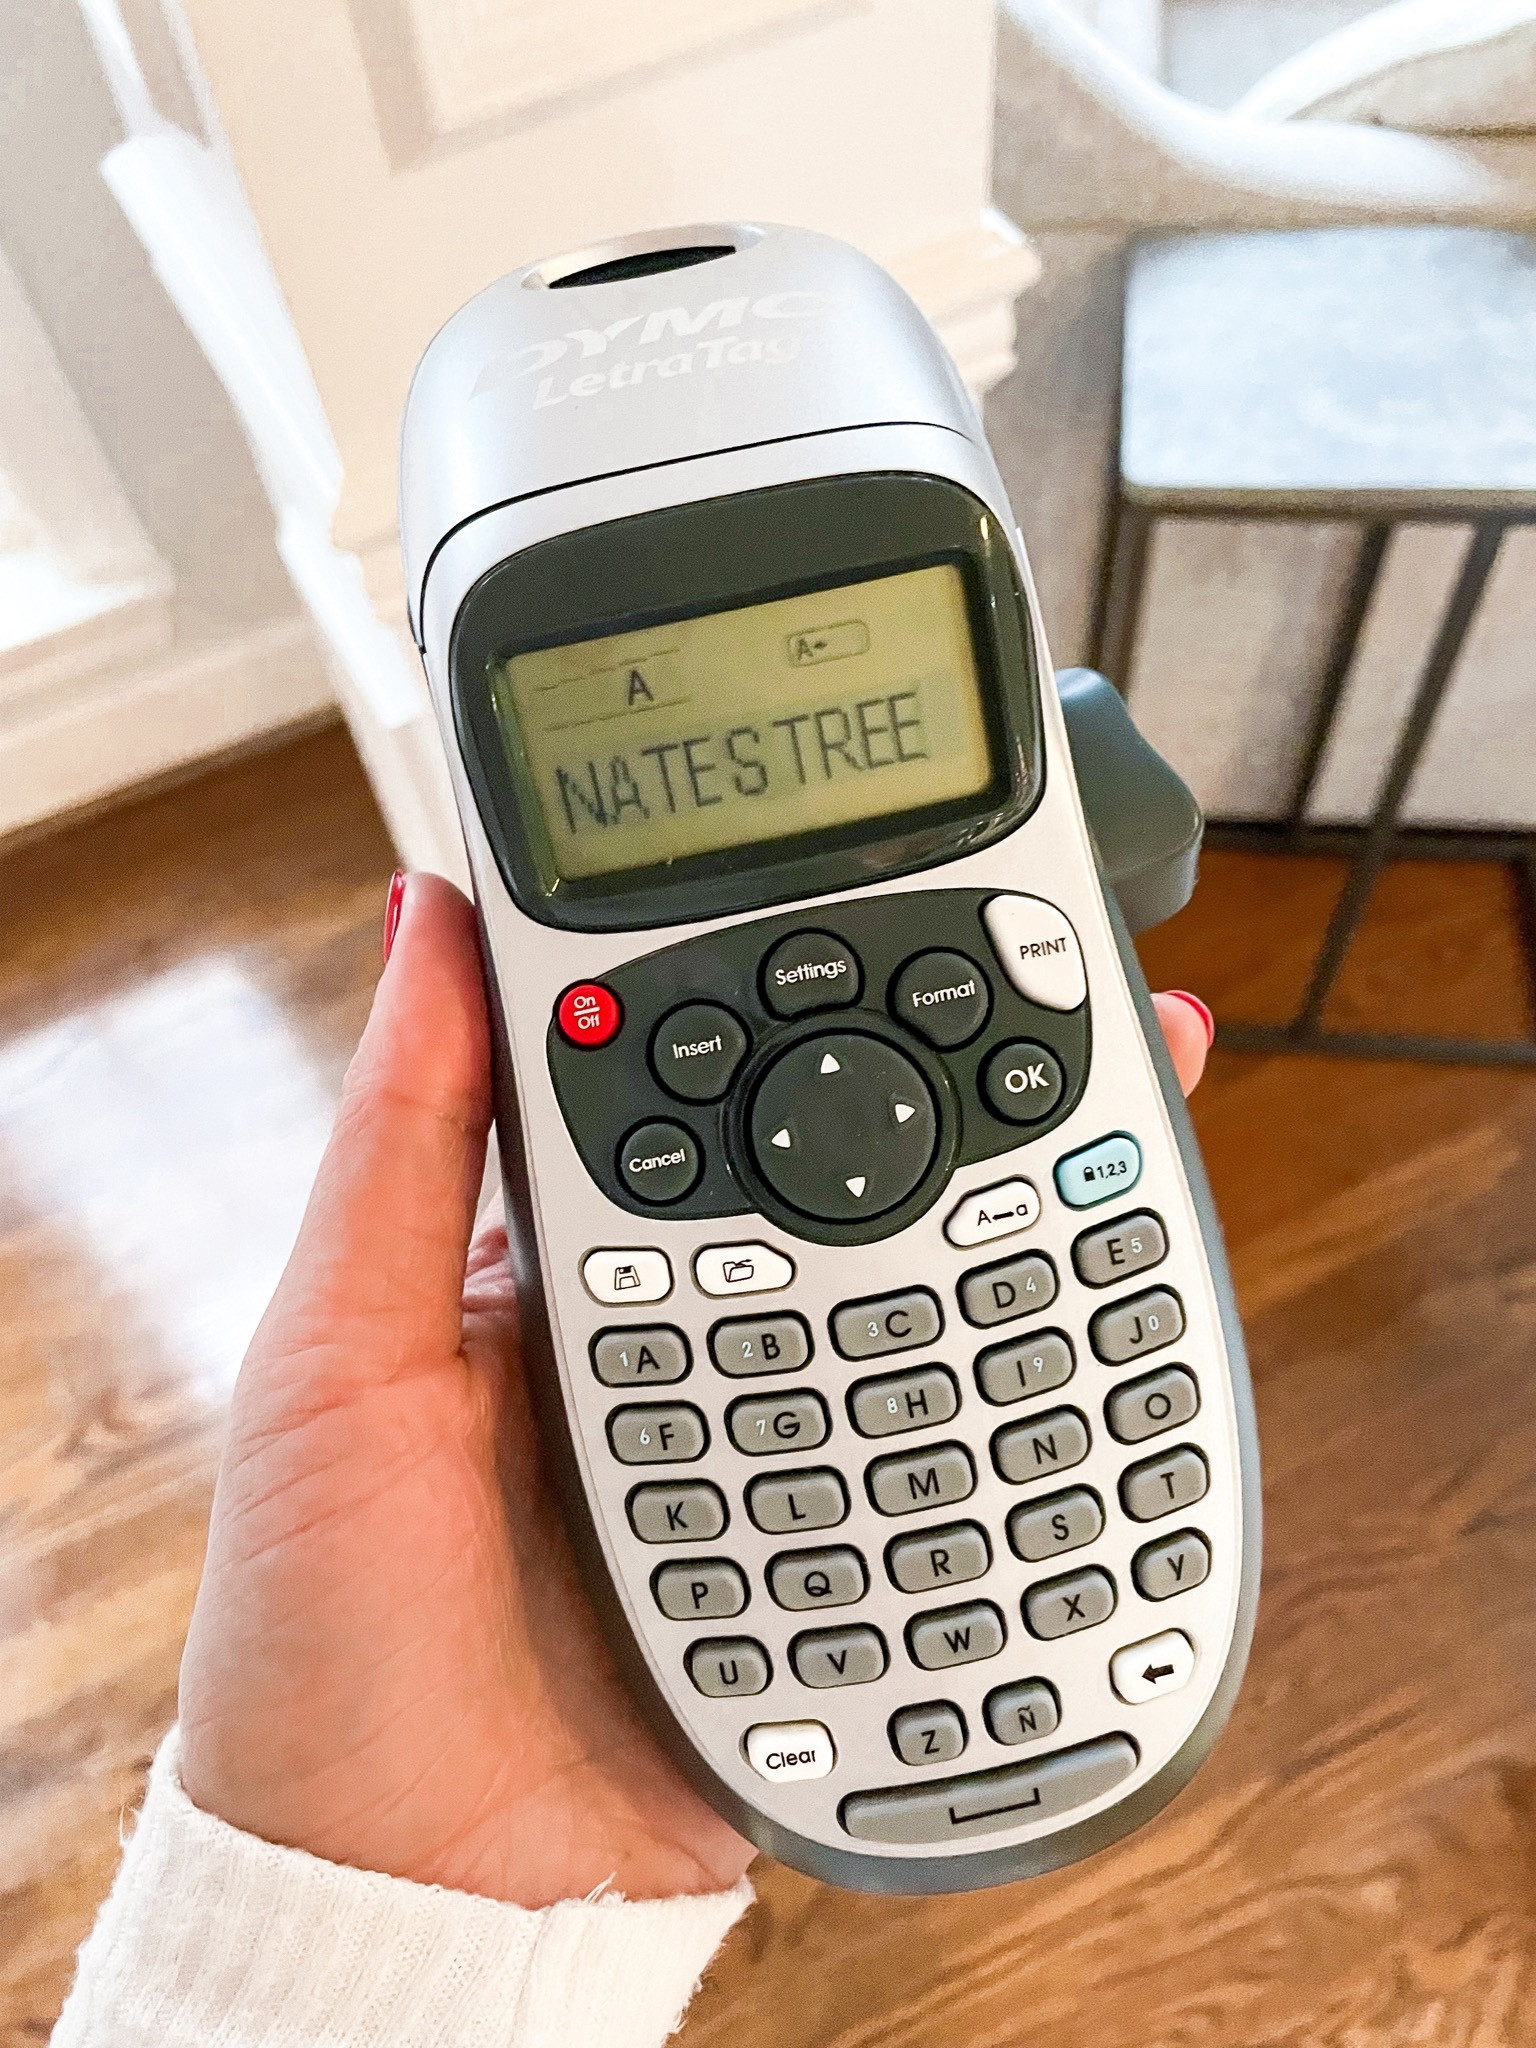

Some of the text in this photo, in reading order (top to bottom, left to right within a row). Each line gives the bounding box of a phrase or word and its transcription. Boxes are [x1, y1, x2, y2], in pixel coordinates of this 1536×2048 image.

[468, 291, 853, 401] DYMO
[533, 334, 802, 410] LetraTag
[627, 669, 655, 706] A
[1019, 937, 1068, 960] PRINT
[775, 958, 847, 986] Settings
[573, 995, 596, 1009] On
[912, 979, 976, 1008] Format
[577, 1013, 600, 1030] Off
[672, 1034, 723, 1059] Insert
[1004, 1063, 1050, 1095] OK
[629, 1148, 686, 1173] Cancel
[1107, 1237, 1143, 1265] E 5
[992, 1276, 1037, 1309] D 4
[867, 1310, 912, 1338] 3 C
[1129, 1316, 1144, 1344] J
[637, 1345, 660, 1374] A
[741, 1333, 781, 1361] 2 B
[1033, 1356, 1044, 1373] 9
[886, 1389, 929, 1418] 8 H
[1145, 1392, 1172, 1420] O
[639, 1422, 675, 1450] 6 F
[756, 1411, 801, 1439] 7 G
[1032, 1433, 1058, 1465] N
[907, 1467, 941, 1500] M
[1160, 1471, 1175, 1500] T
[665, 1500, 689, 1531] K
[787, 1493, 806, 1521] L
[1051, 1514, 1070, 1541] S
[930, 1548, 952, 1577] R
[1166, 1553, 1184, 1581] Y
[691, 1582, 708, 1609] P
[804, 1570, 832, 1597] Q
[1062, 1593, 1086, 1622] X
[943, 1626, 971, 1653] W
[719, 1660, 739, 1685] U
[827, 1649, 848, 1675] V
[1017, 1704, 1037, 1733] Ñ
[921, 1730, 940, 1755] Z
[766, 1749, 816, 1770] Clear
